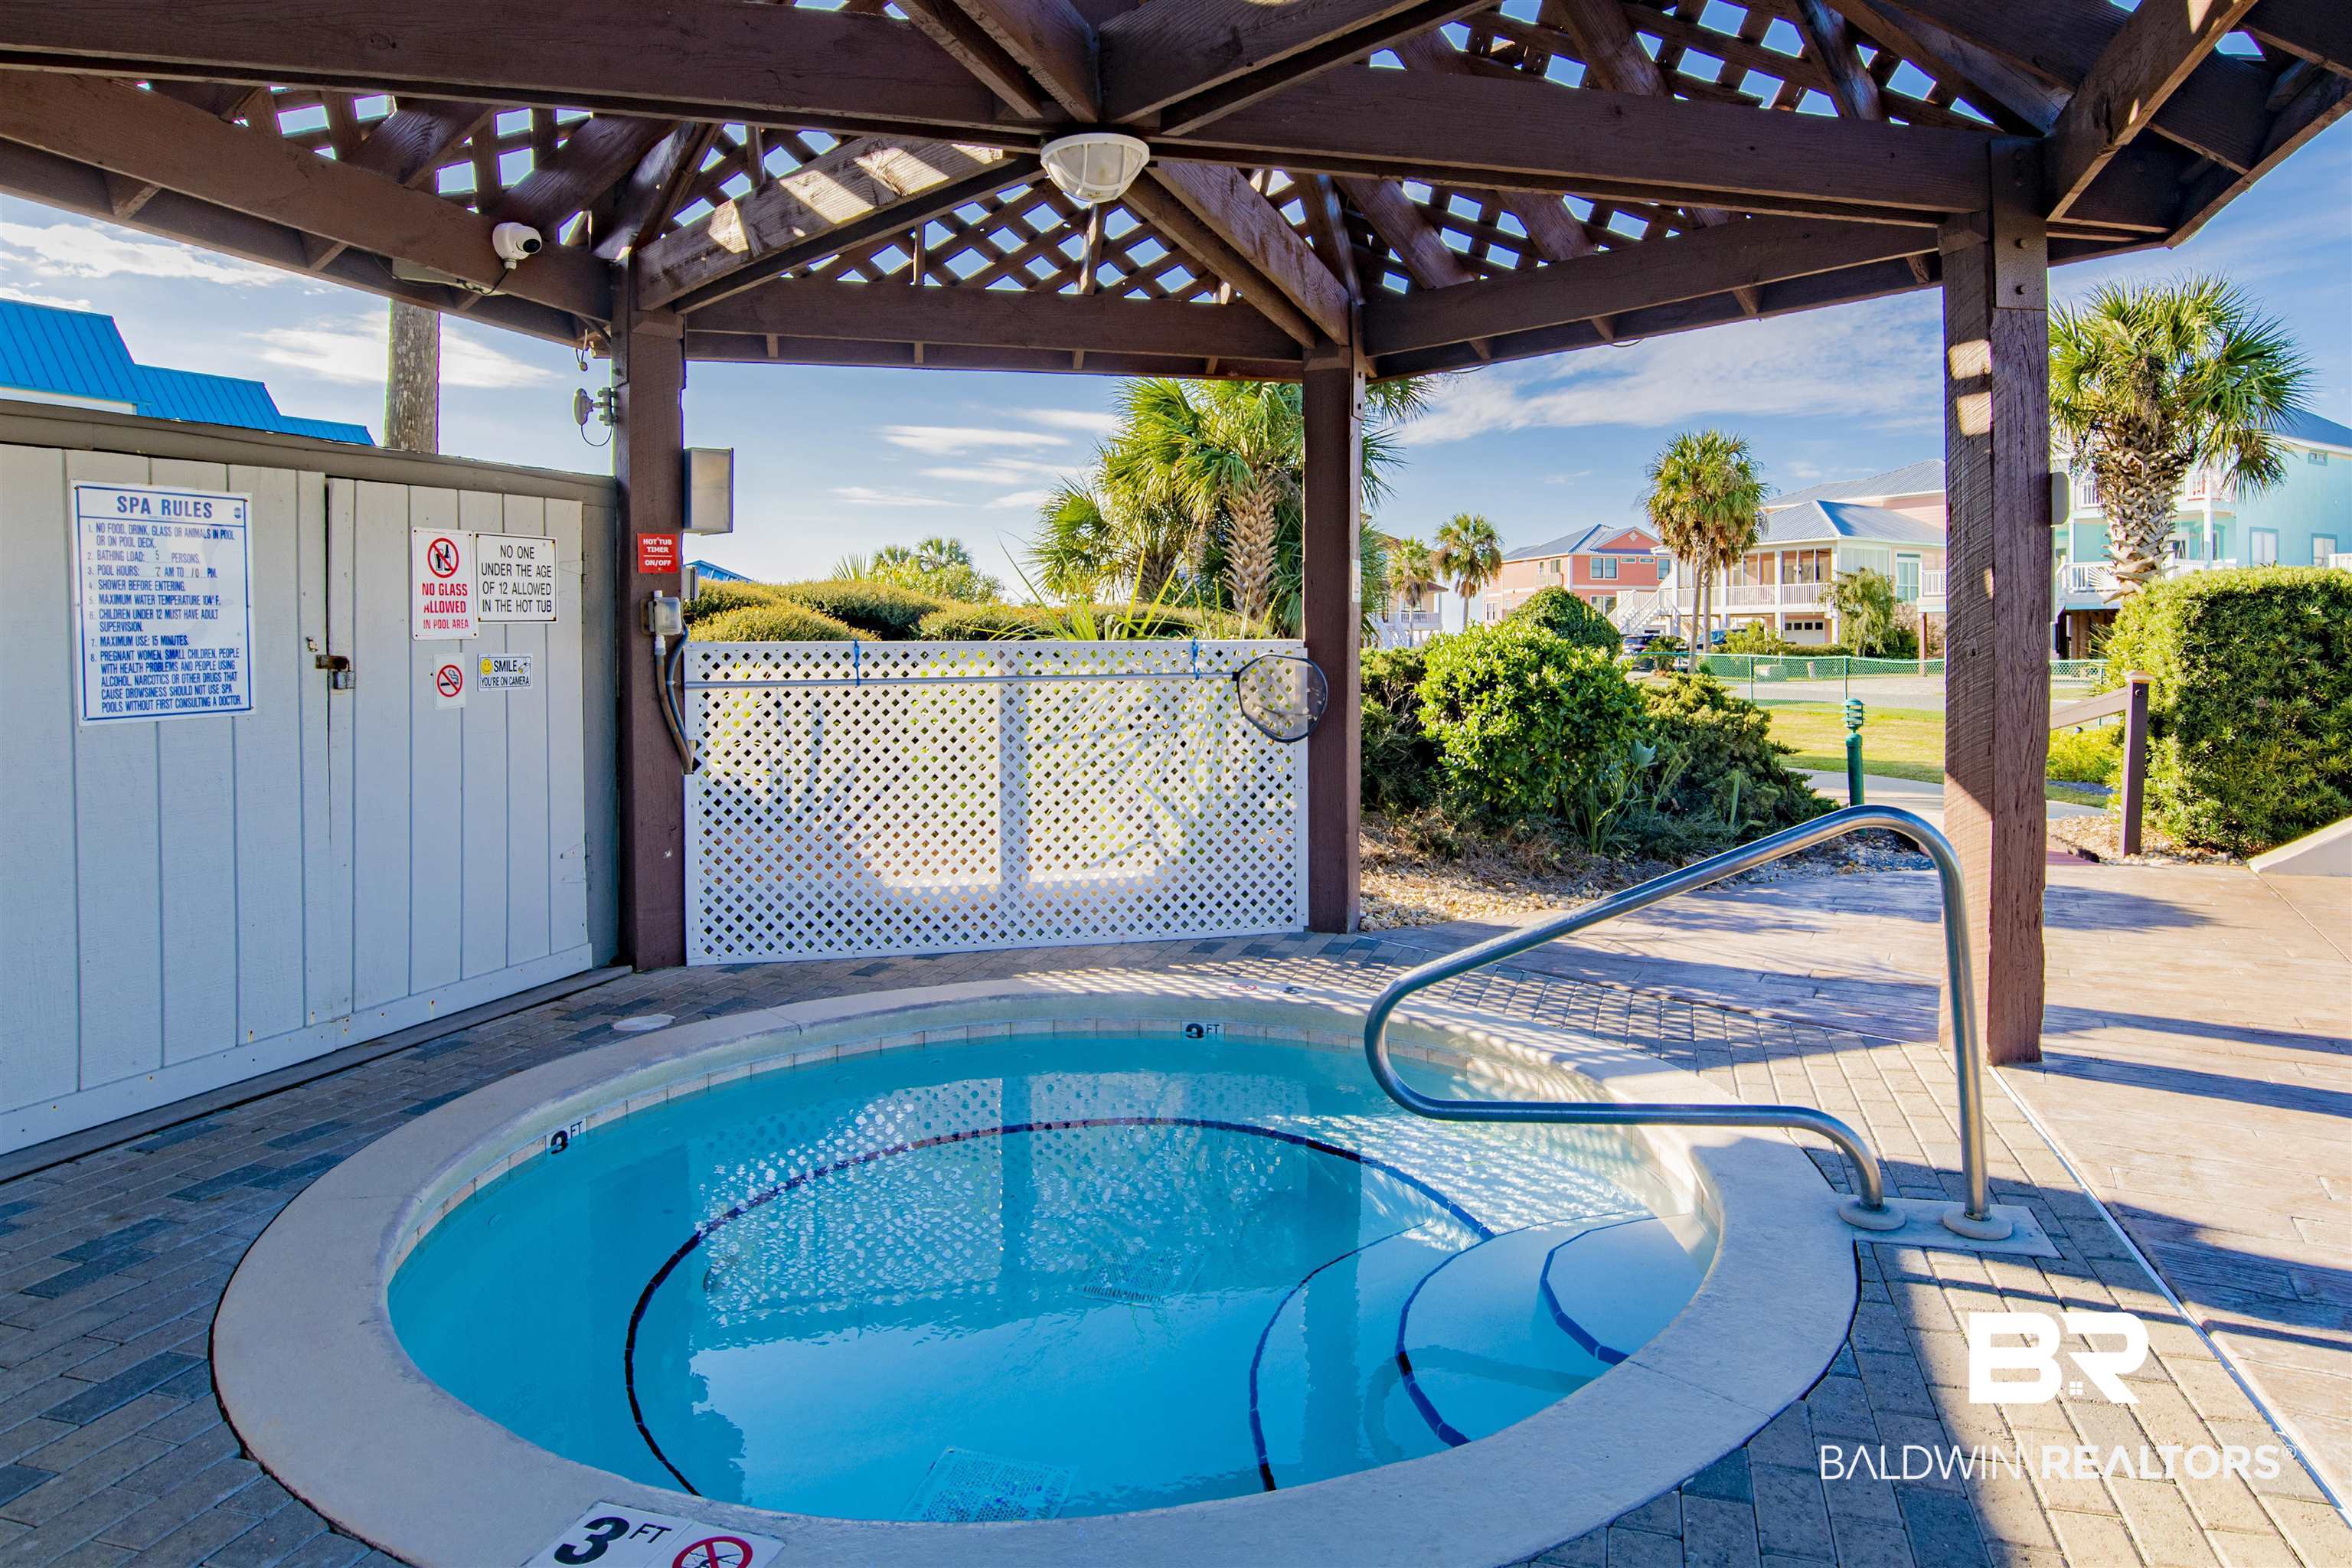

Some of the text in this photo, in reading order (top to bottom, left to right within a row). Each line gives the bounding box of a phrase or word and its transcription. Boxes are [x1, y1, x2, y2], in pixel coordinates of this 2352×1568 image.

[117, 495, 212, 518] SPA RULES
[96, 523, 105, 534] NO
[152, 525, 172, 536] GLASS
[174, 527, 182, 537] OR
[185, 527, 211, 539] ANIMALS
[212, 529, 219, 539] IN
[220, 529, 234, 540] POOL
[96, 536, 157, 549] OR ON POOL DECK.
[97, 550, 124, 562] BATHING
[127, 550, 145, 562] LOAD:
[500, 545, 535, 559] NO ONE
[97, 565, 113, 576] POOL
[116, 566, 140, 576] HOURS:
[164, 567, 175, 577] AM
[176, 567, 184, 577] TO
[481, 562, 552, 578] UNDER THE AGE
[98, 580, 126, 591] SHOWER
[129, 581, 152, 591] BEFORE
[422, 583, 468, 596] NO GLASS
[482, 581, 551, 595] OF 12 ALLOWED
[99, 594, 132, 605] MAXIMUM
[134, 595, 156, 605] WATER
[158, 595, 200, 606] TEMPERATURE
[424, 600, 466, 613] ALLOWED
[482, 599, 552, 612] IN THE HOT TUB
[99, 609, 131, 619] CHILDREN
[133, 609, 153, 619] UNDER
[156, 609, 162, 619] 12
[165, 609, 181, 619] MUST
[184, 609, 199, 619] HAVE
[201, 609, 218, 619] ADULT
[100, 621, 144, 632] SUPERVISION.
[423, 619, 469, 629] IN POOL AREA
[100, 636, 133, 647] MAXIMUM
[136, 636, 150, 647] USE:
[152, 636, 158, 646] 15
[160, 635, 189, 646] MINUTES.
[100, 650, 134, 662] PREGNANT
[165, 649, 185, 660] SMALL
[219, 648, 239, 658] PEOPLE
[101, 660, 235, 674] WITH HEALTH PROBLEMS AND PEOPLE USING
[494, 660, 517, 672] SMILE
[134, 675, 169, 686] NARCOTICS
[172, 674, 180, 684] OR
[182, 673, 200, 684] OTHER
[203, 673, 222, 683] DRUGS
[223, 671, 237, 682] THAT
[500, 676, 508, 686] ON
[509, 676, 529, 686] CAMERA
[102, 683, 233, 700] CAUSE DROWSINESS SHOULD NOT USE SPA
[102, 695, 242, 713] POOLS WITHOUT FIRST CONSULTING A DOCTOR.
[1207, 1024, 1220, 1034] FT
[570, 1120, 582, 1138] FT
[554, 1517, 672, 1565] 3 FT
